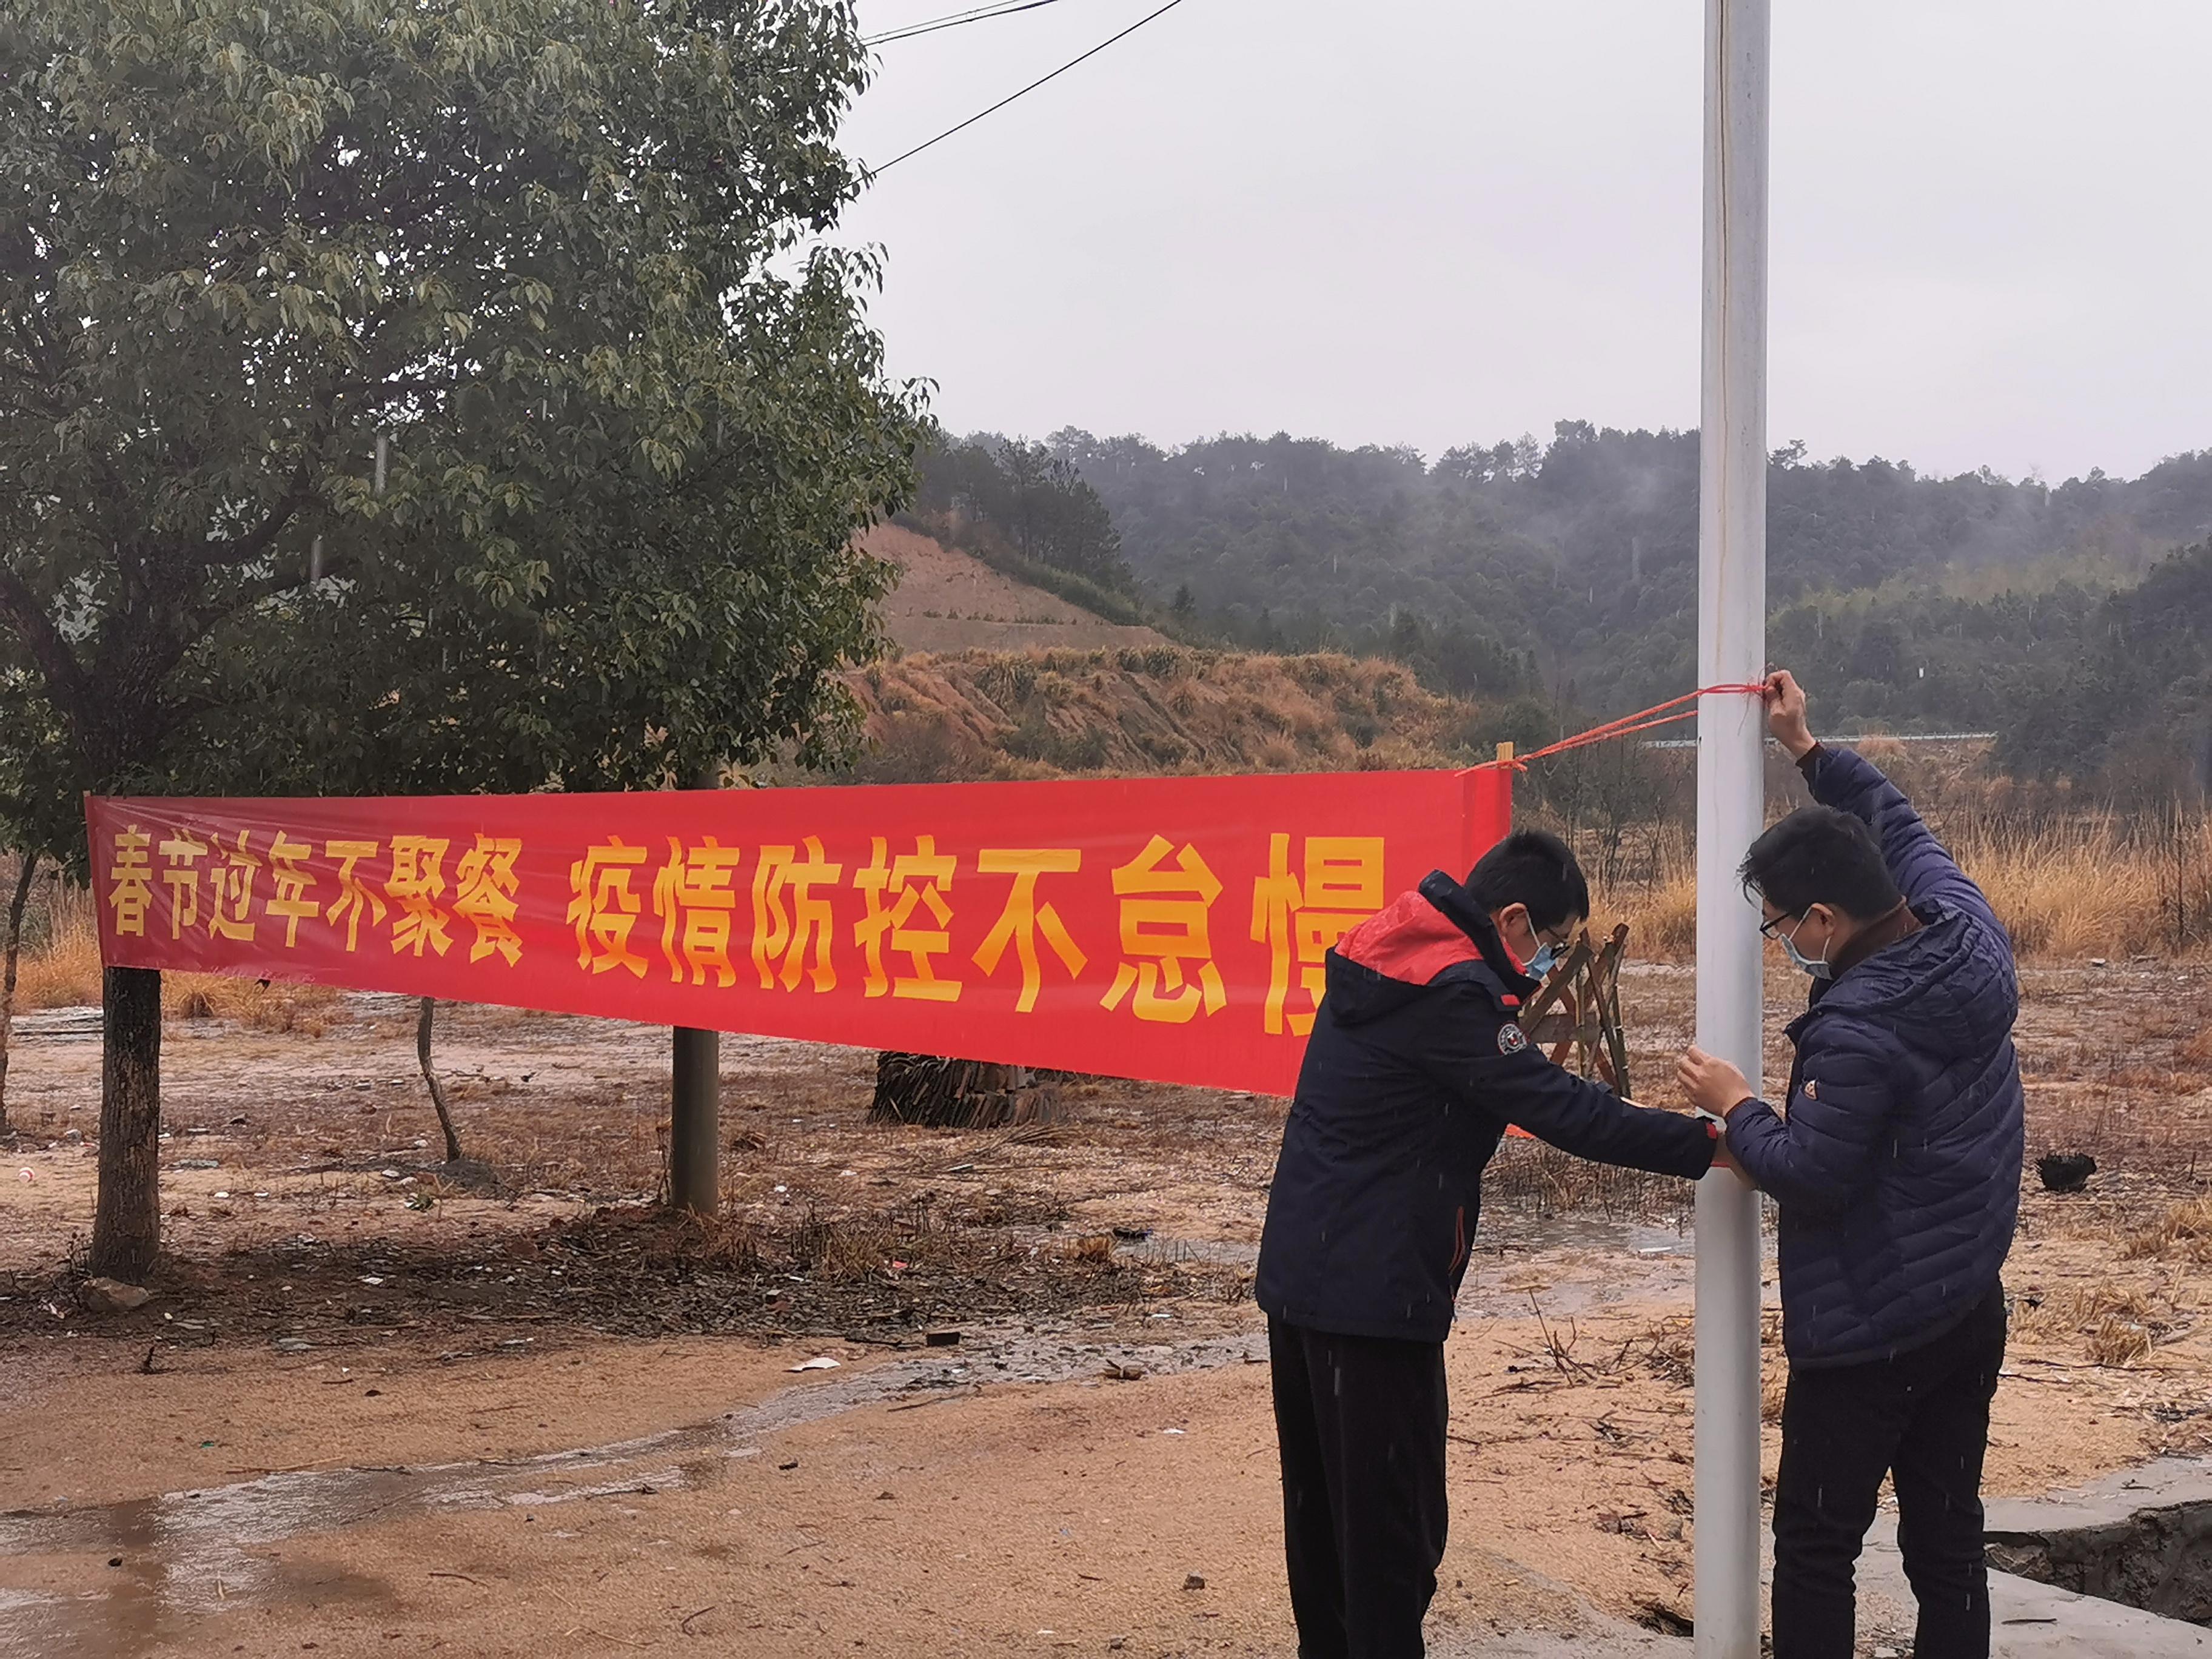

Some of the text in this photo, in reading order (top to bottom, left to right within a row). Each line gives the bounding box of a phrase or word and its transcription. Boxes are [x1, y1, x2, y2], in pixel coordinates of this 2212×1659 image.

[108, 823, 1385, 1037] 春节过年不聚餐 疫情防控不怠慢
